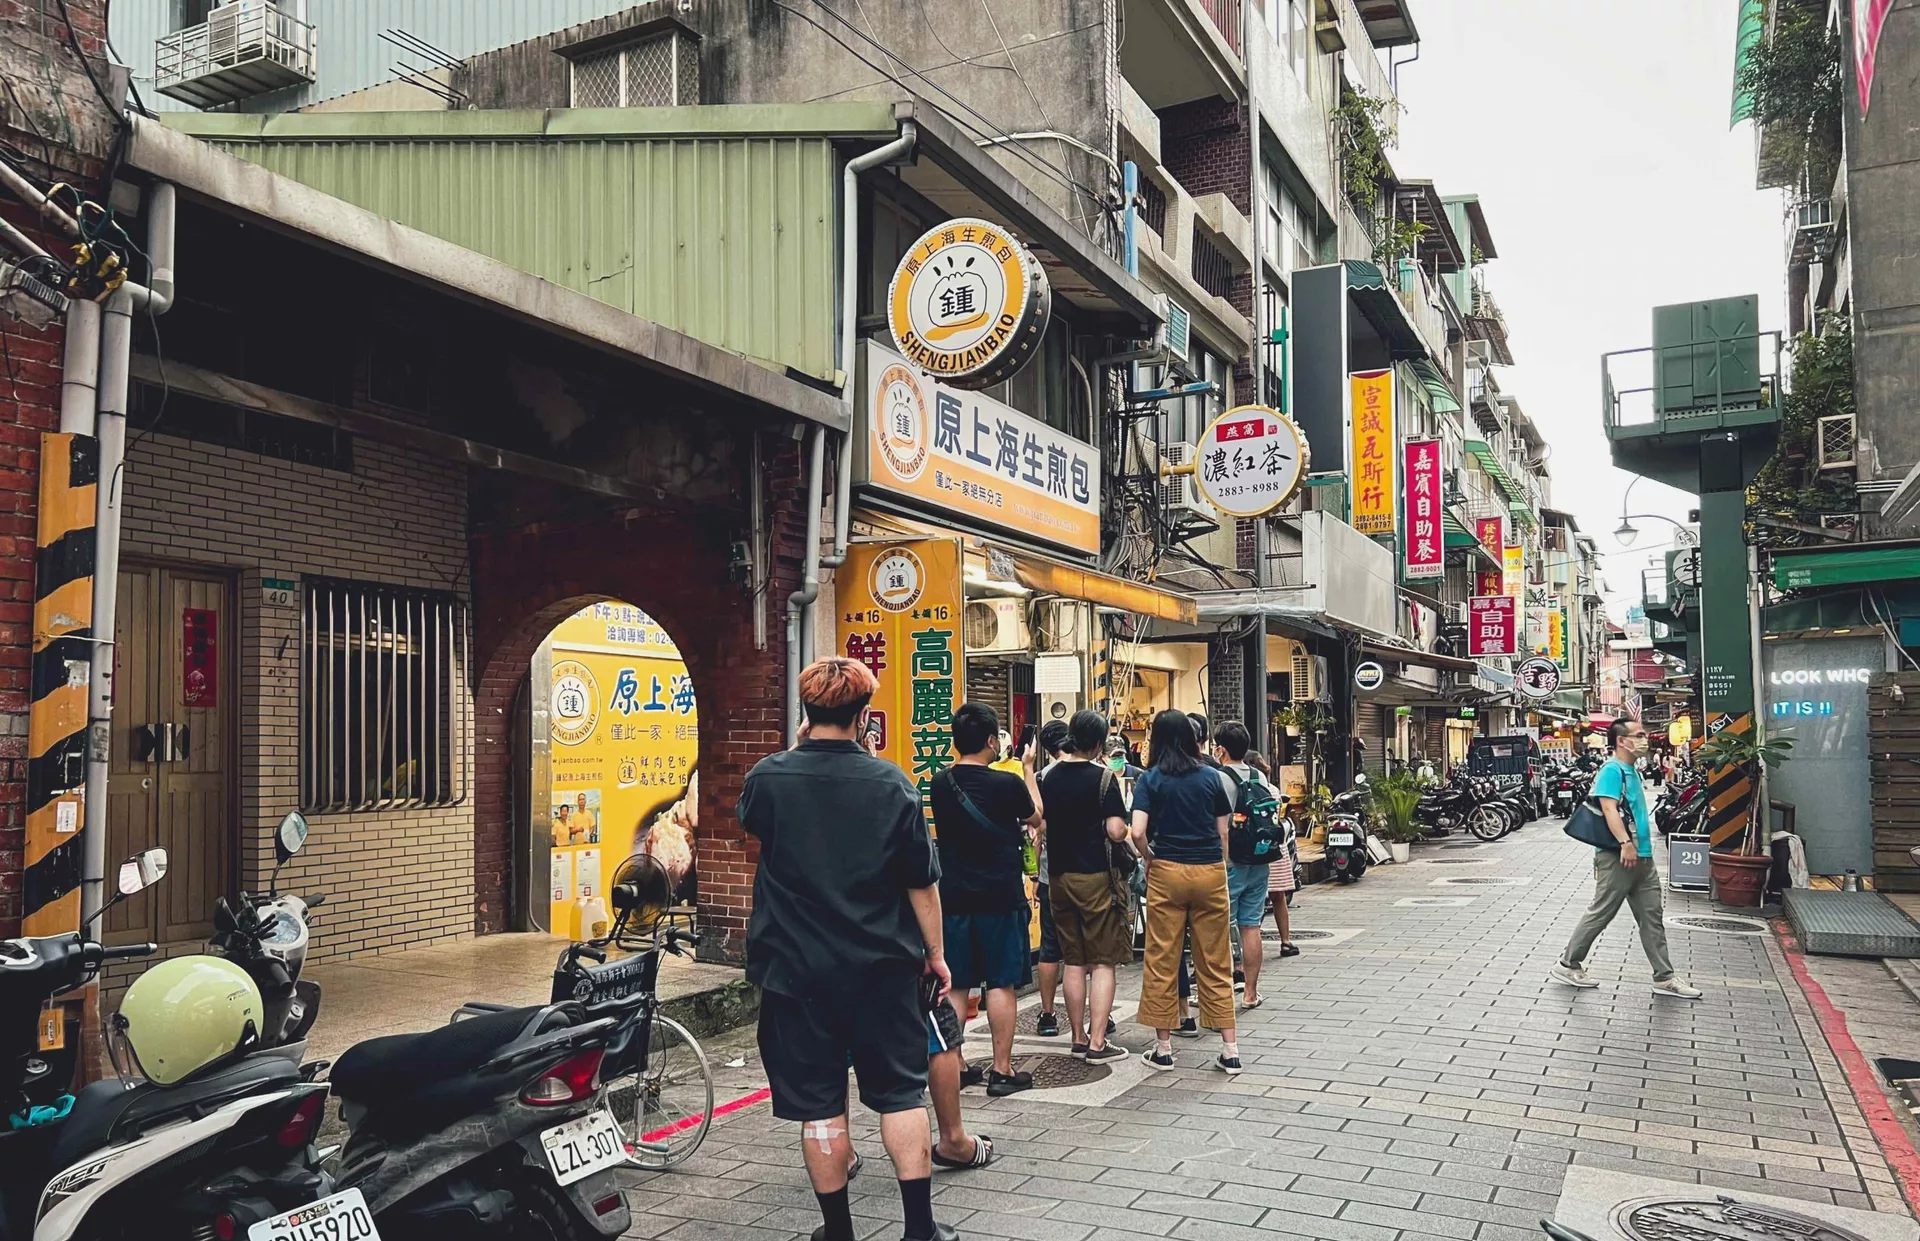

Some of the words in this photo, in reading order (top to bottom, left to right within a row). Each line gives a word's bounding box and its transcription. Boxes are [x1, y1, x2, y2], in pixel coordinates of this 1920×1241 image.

[905, 226, 1012, 276] 原上海生煎包
[901, 313, 1015, 370] SHENGJIANBAO
[880, 432, 925, 475] SHENGJIANBAO
[934, 390, 1090, 504] 原上海生煎包
[1204, 440, 1292, 482] 濃紅茶
[1218, 481, 1279, 497] 2883-8988
[1413, 448, 1436, 561] 嘉賓自助餐
[270, 591, 288, 604] 40
[873, 589, 921, 611] SHENGJIANBAO
[866, 609, 880, 623] 16
[934, 606, 948, 620] 16
[1480, 610, 1505, 653] 自助餐
[1520, 664, 1558, 690] 吉野
[1771, 670, 1822, 685] LOOK
[609, 669, 695, 715] 原上海
[1773, 702, 1789, 715] IT
[1795, 702, 1813, 715] IS
[678, 756, 687, 767] 16
[678, 774, 687, 785] 16
[1681, 851, 1702, 865] 29
